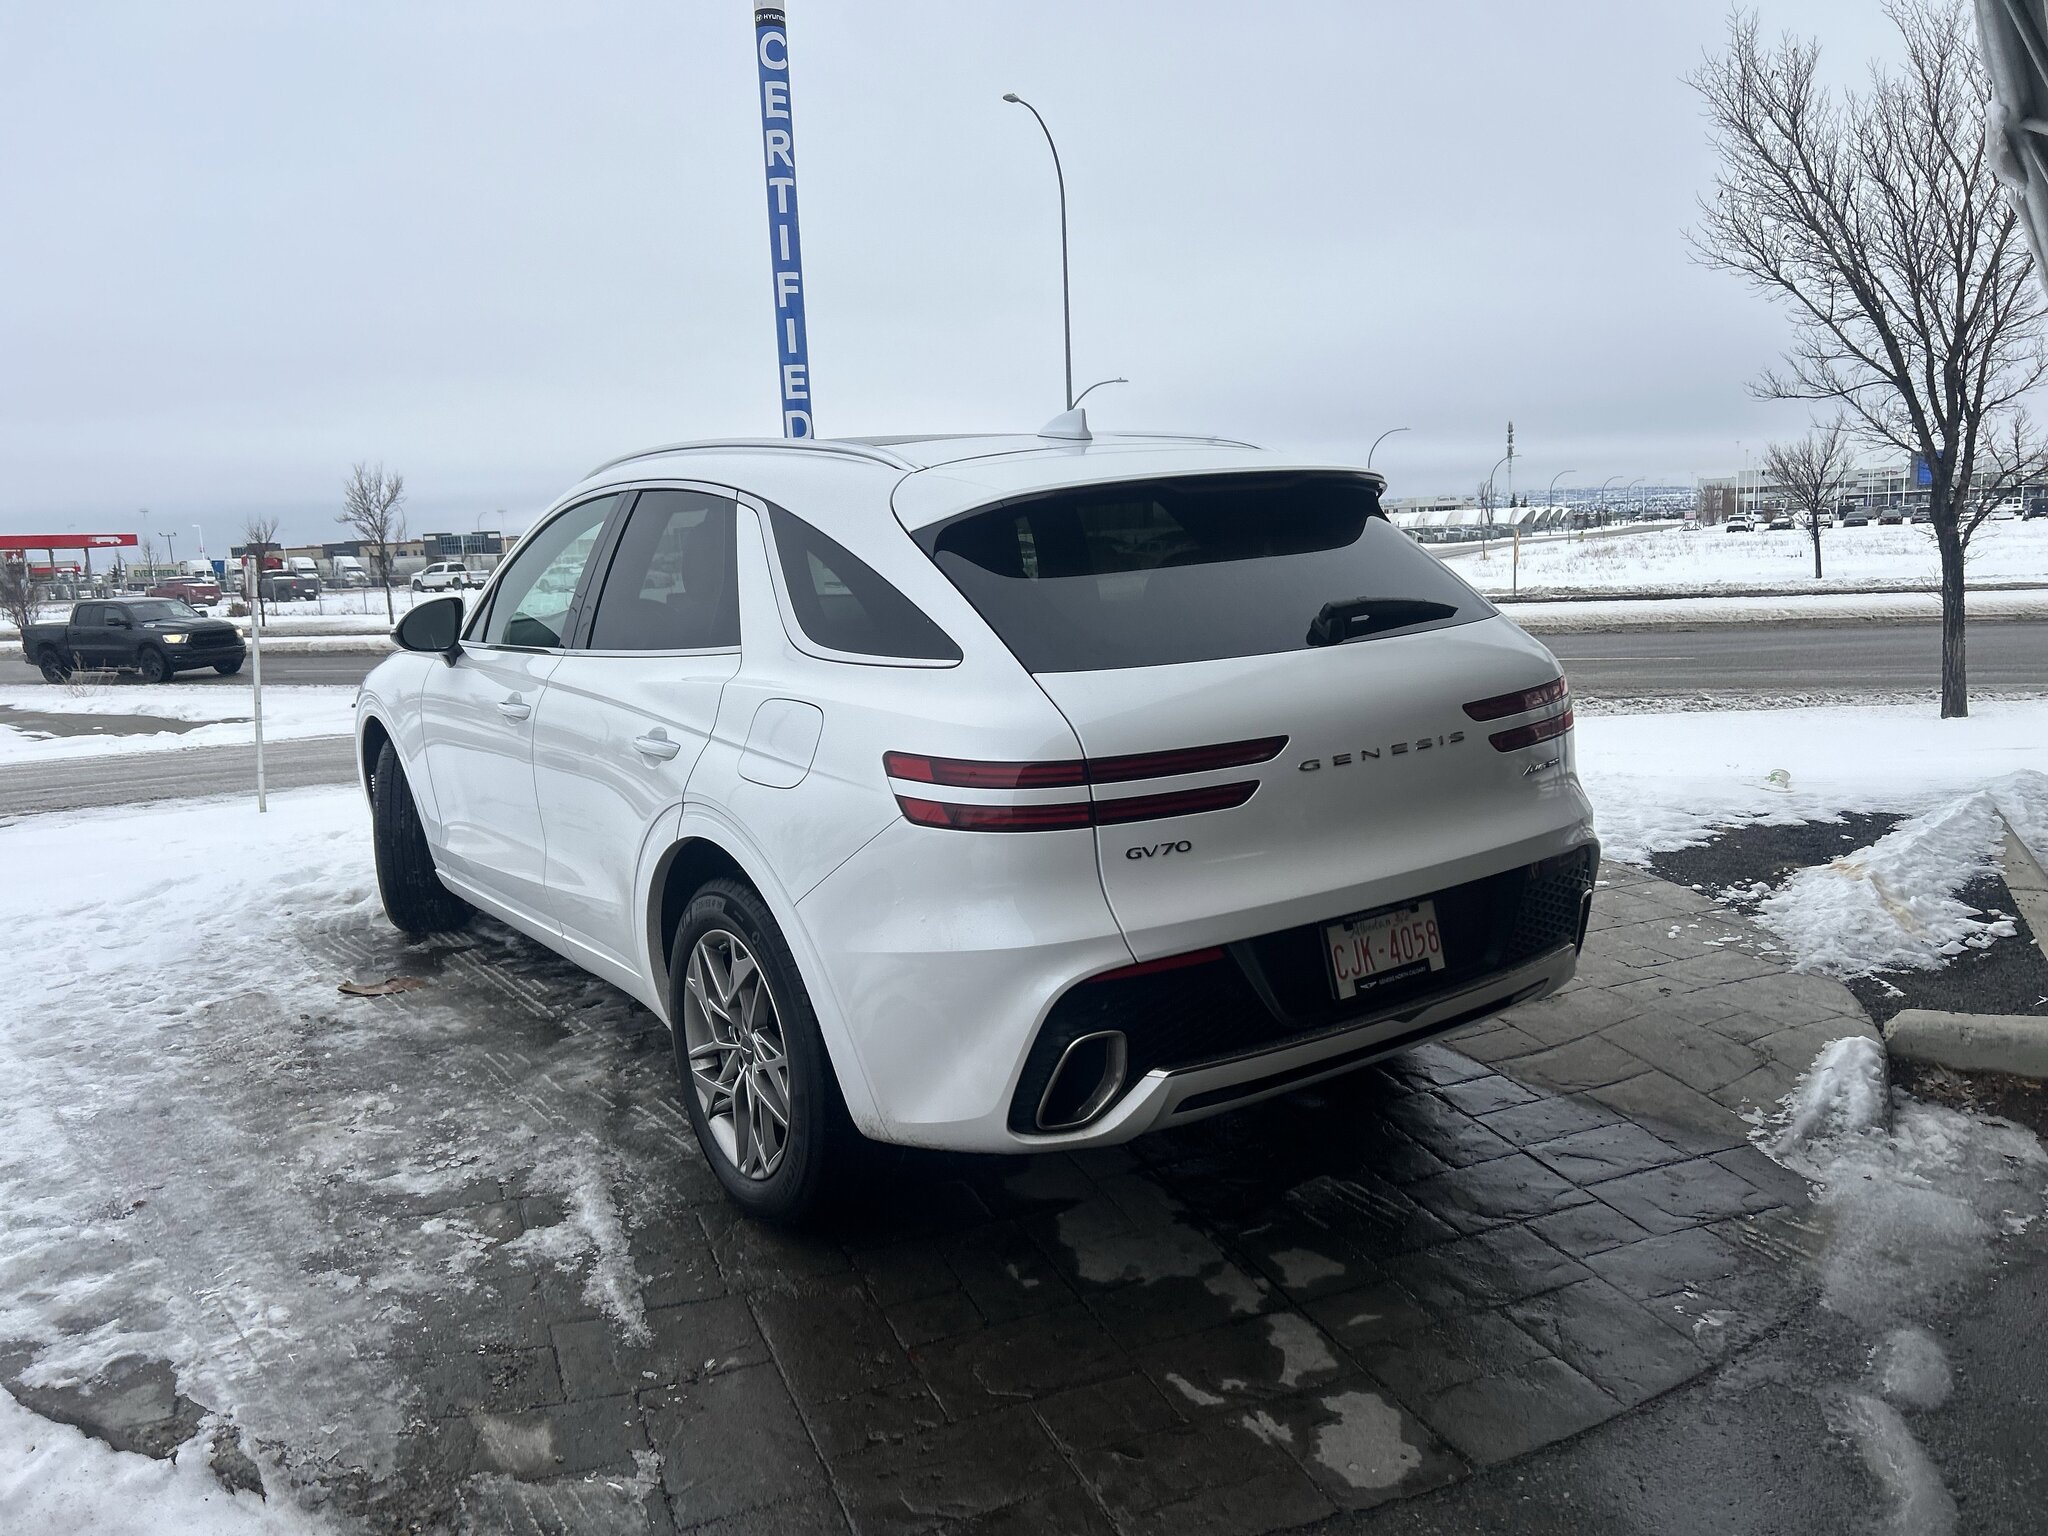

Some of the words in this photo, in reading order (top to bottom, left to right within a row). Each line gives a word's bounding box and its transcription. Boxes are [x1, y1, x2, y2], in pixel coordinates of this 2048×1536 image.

[759, 31, 813, 438] CERTIFIED
[133, 569, 177, 577] EVERGREEN
[1297, 731, 1465, 772] GENESIS
[1125, 840, 1192, 860] GV70
[1333, 919, 1440, 981] CJK-4058
